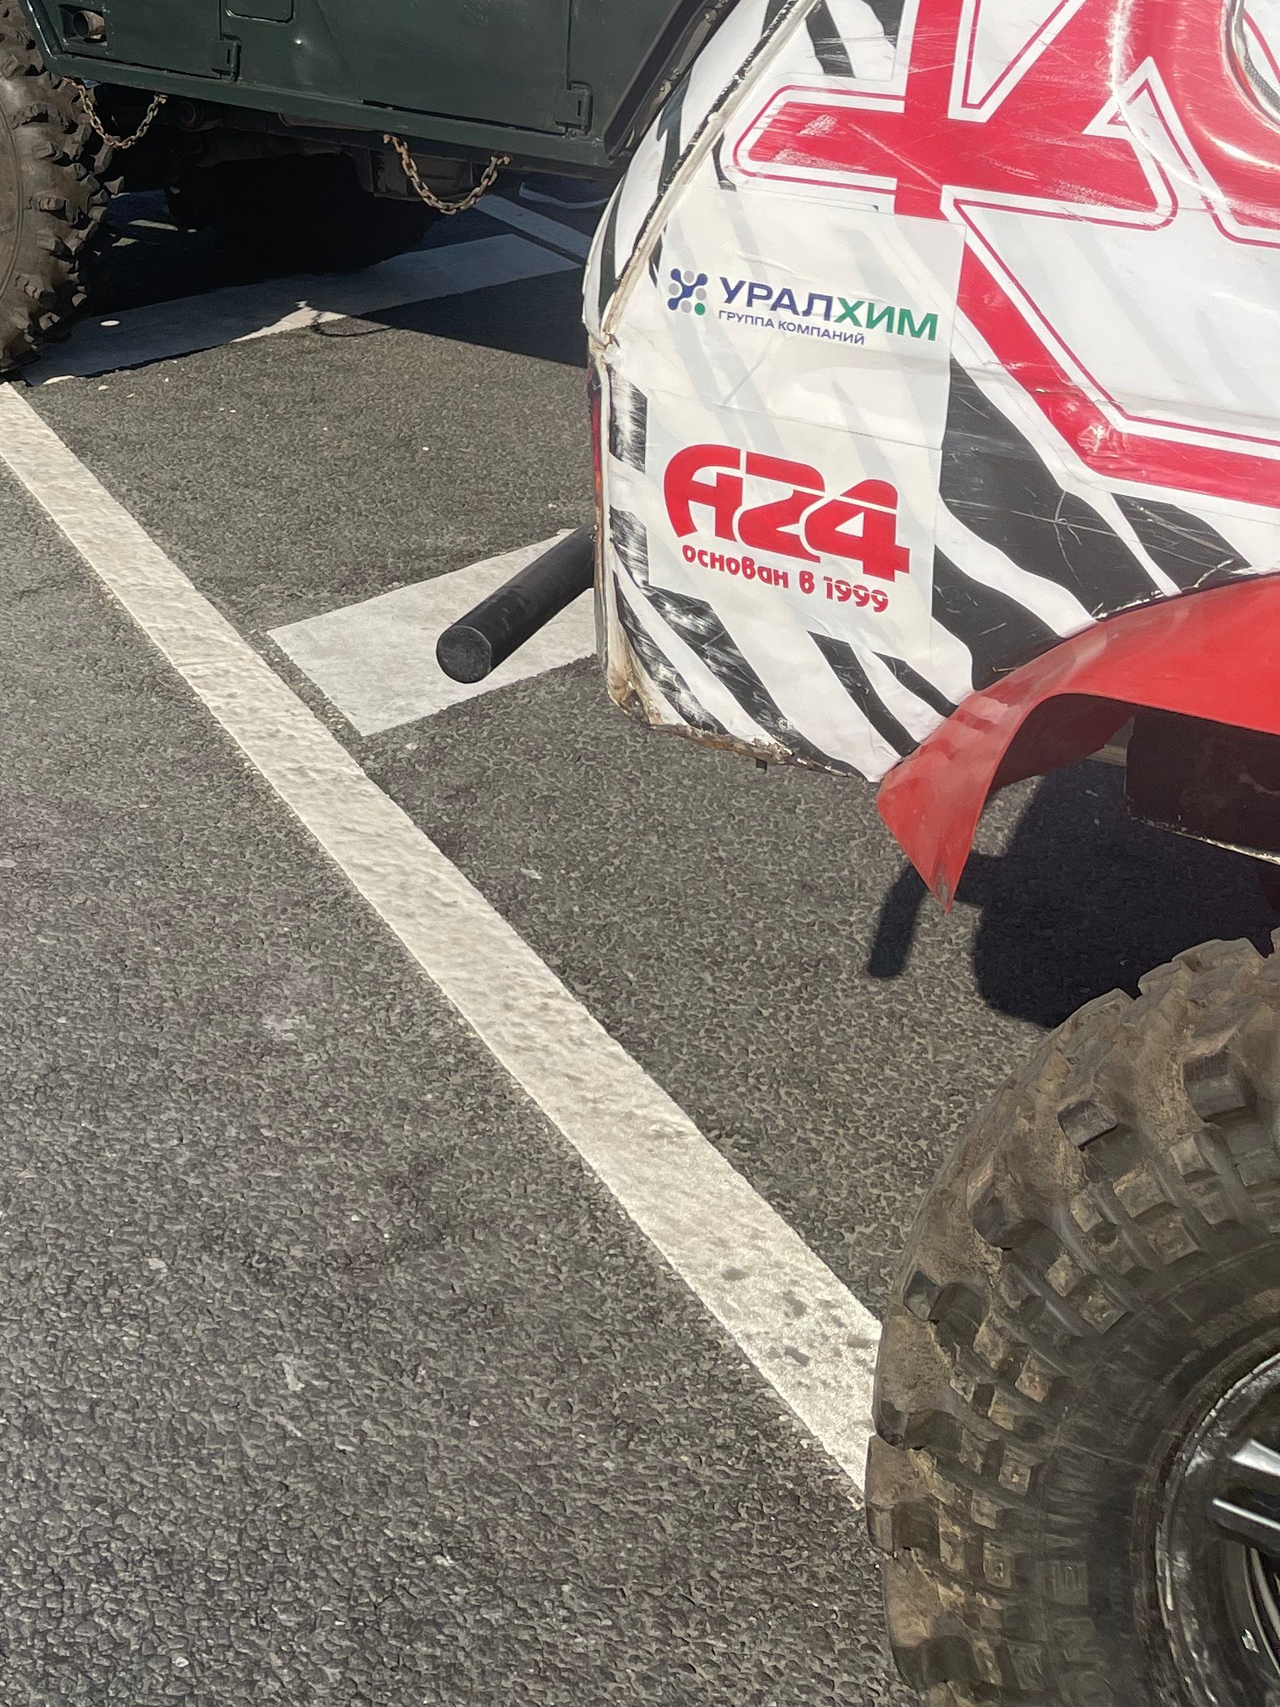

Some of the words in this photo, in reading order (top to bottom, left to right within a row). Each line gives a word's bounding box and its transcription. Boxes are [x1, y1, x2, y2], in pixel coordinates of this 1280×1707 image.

[719, 276, 939, 342] УРАЛХИМ
[719, 310, 775, 329] ГРУППА
[777, 320, 865, 345] КОМПАНИЙ
[682, 544, 789, 588] основан
[823, 575, 889, 613] 1999
